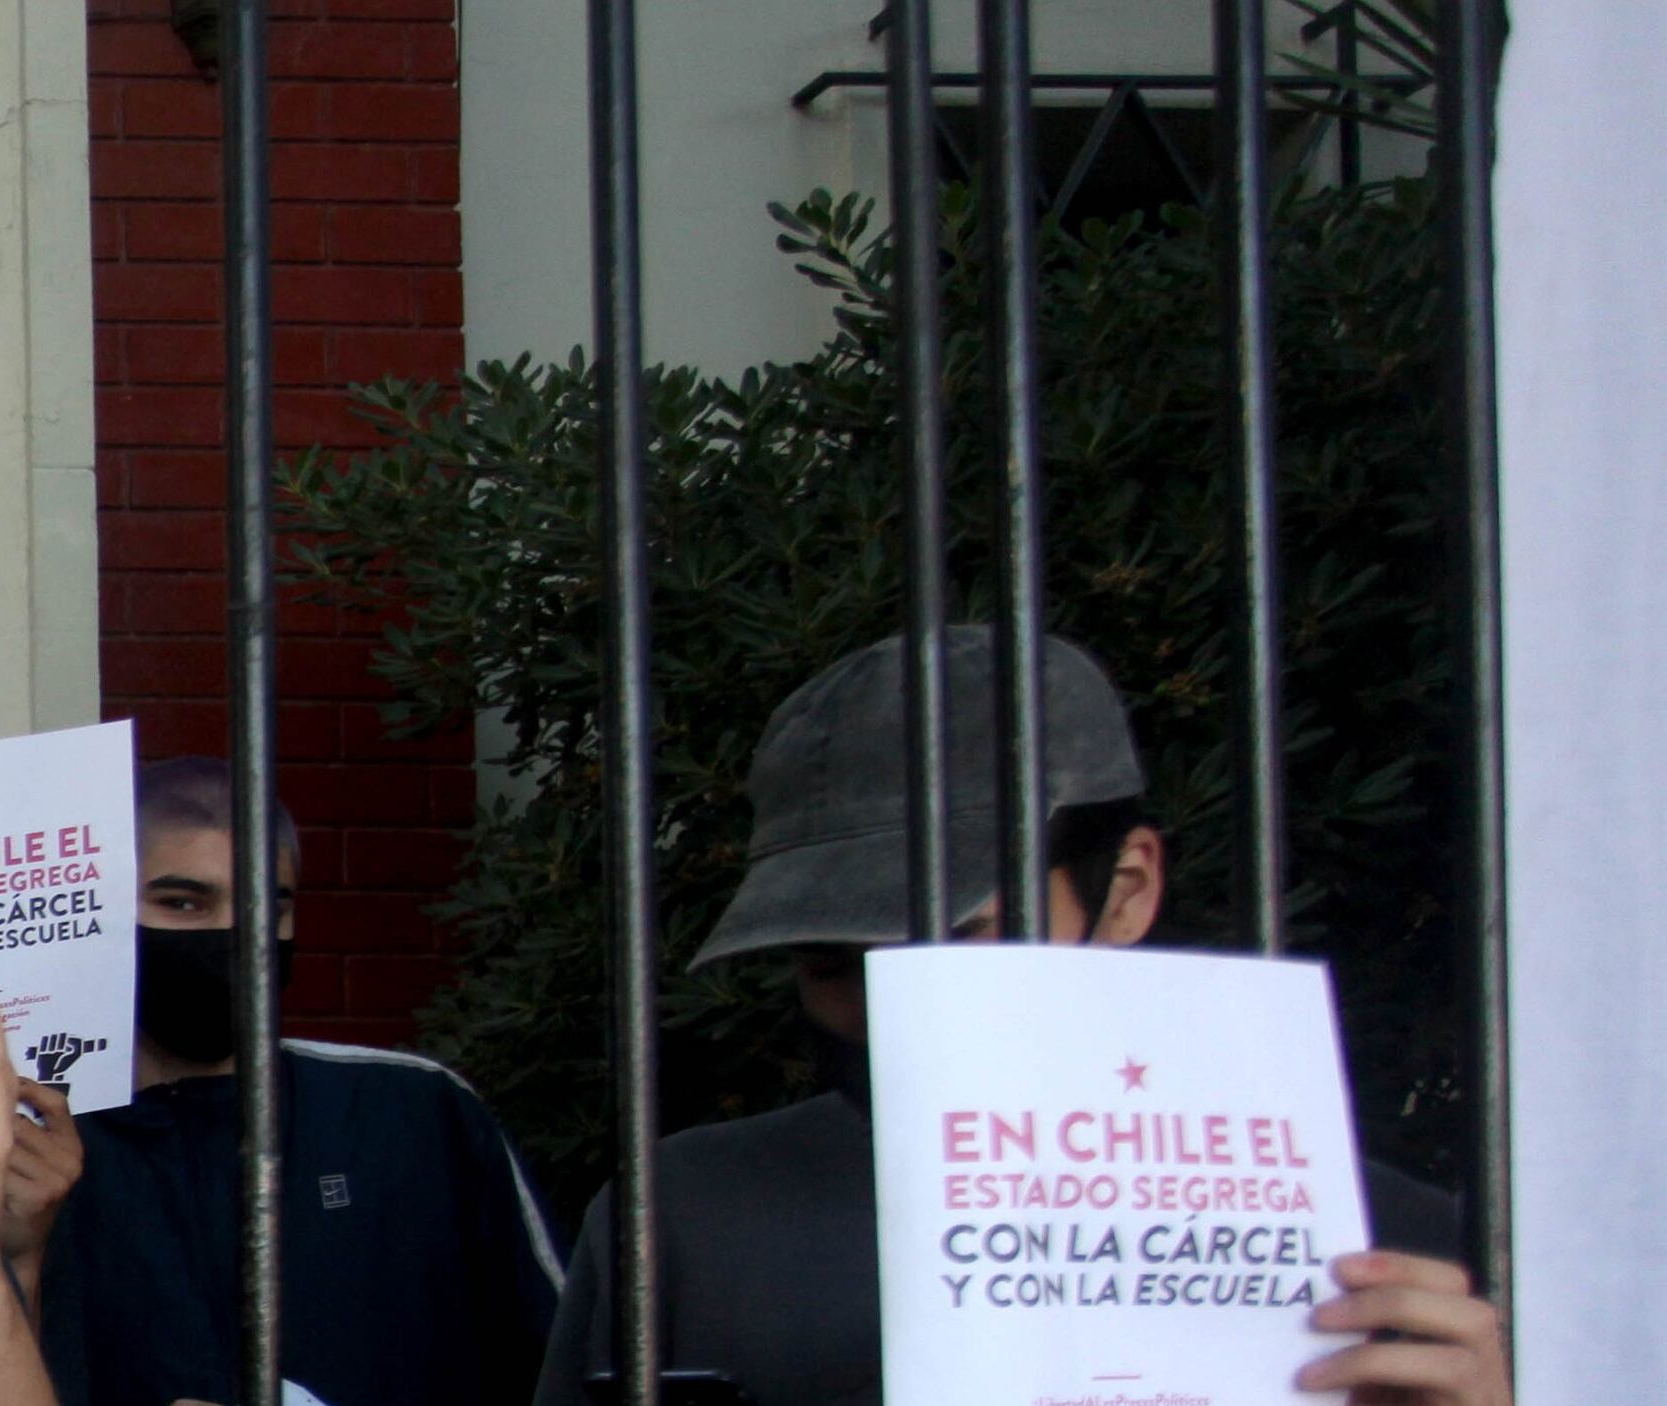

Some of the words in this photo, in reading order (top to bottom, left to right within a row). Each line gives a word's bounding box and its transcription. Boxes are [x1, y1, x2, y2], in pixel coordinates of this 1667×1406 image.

[58, 824, 101, 858] EL
[942, 1110, 1037, 1164] EN
[1056, 1111, 1234, 1166] CHILE
[1246, 1117, 1310, 1169] EL
[943, 1173, 1120, 1211] ESTADO
[1130, 1175, 1316, 1214] SEGREGA
[940, 1223, 1051, 1265] CON
[1066, 1224, 1122, 1265] LA
[1136, 1213, 1324, 1267] CÁRCEL
[941, 1273, 972, 1309] Y
[985, 1273, 1065, 1308] CON
[1076, 1274, 1121, 1307] LA
[1132, 1273, 1317, 1308] ESCUELA
